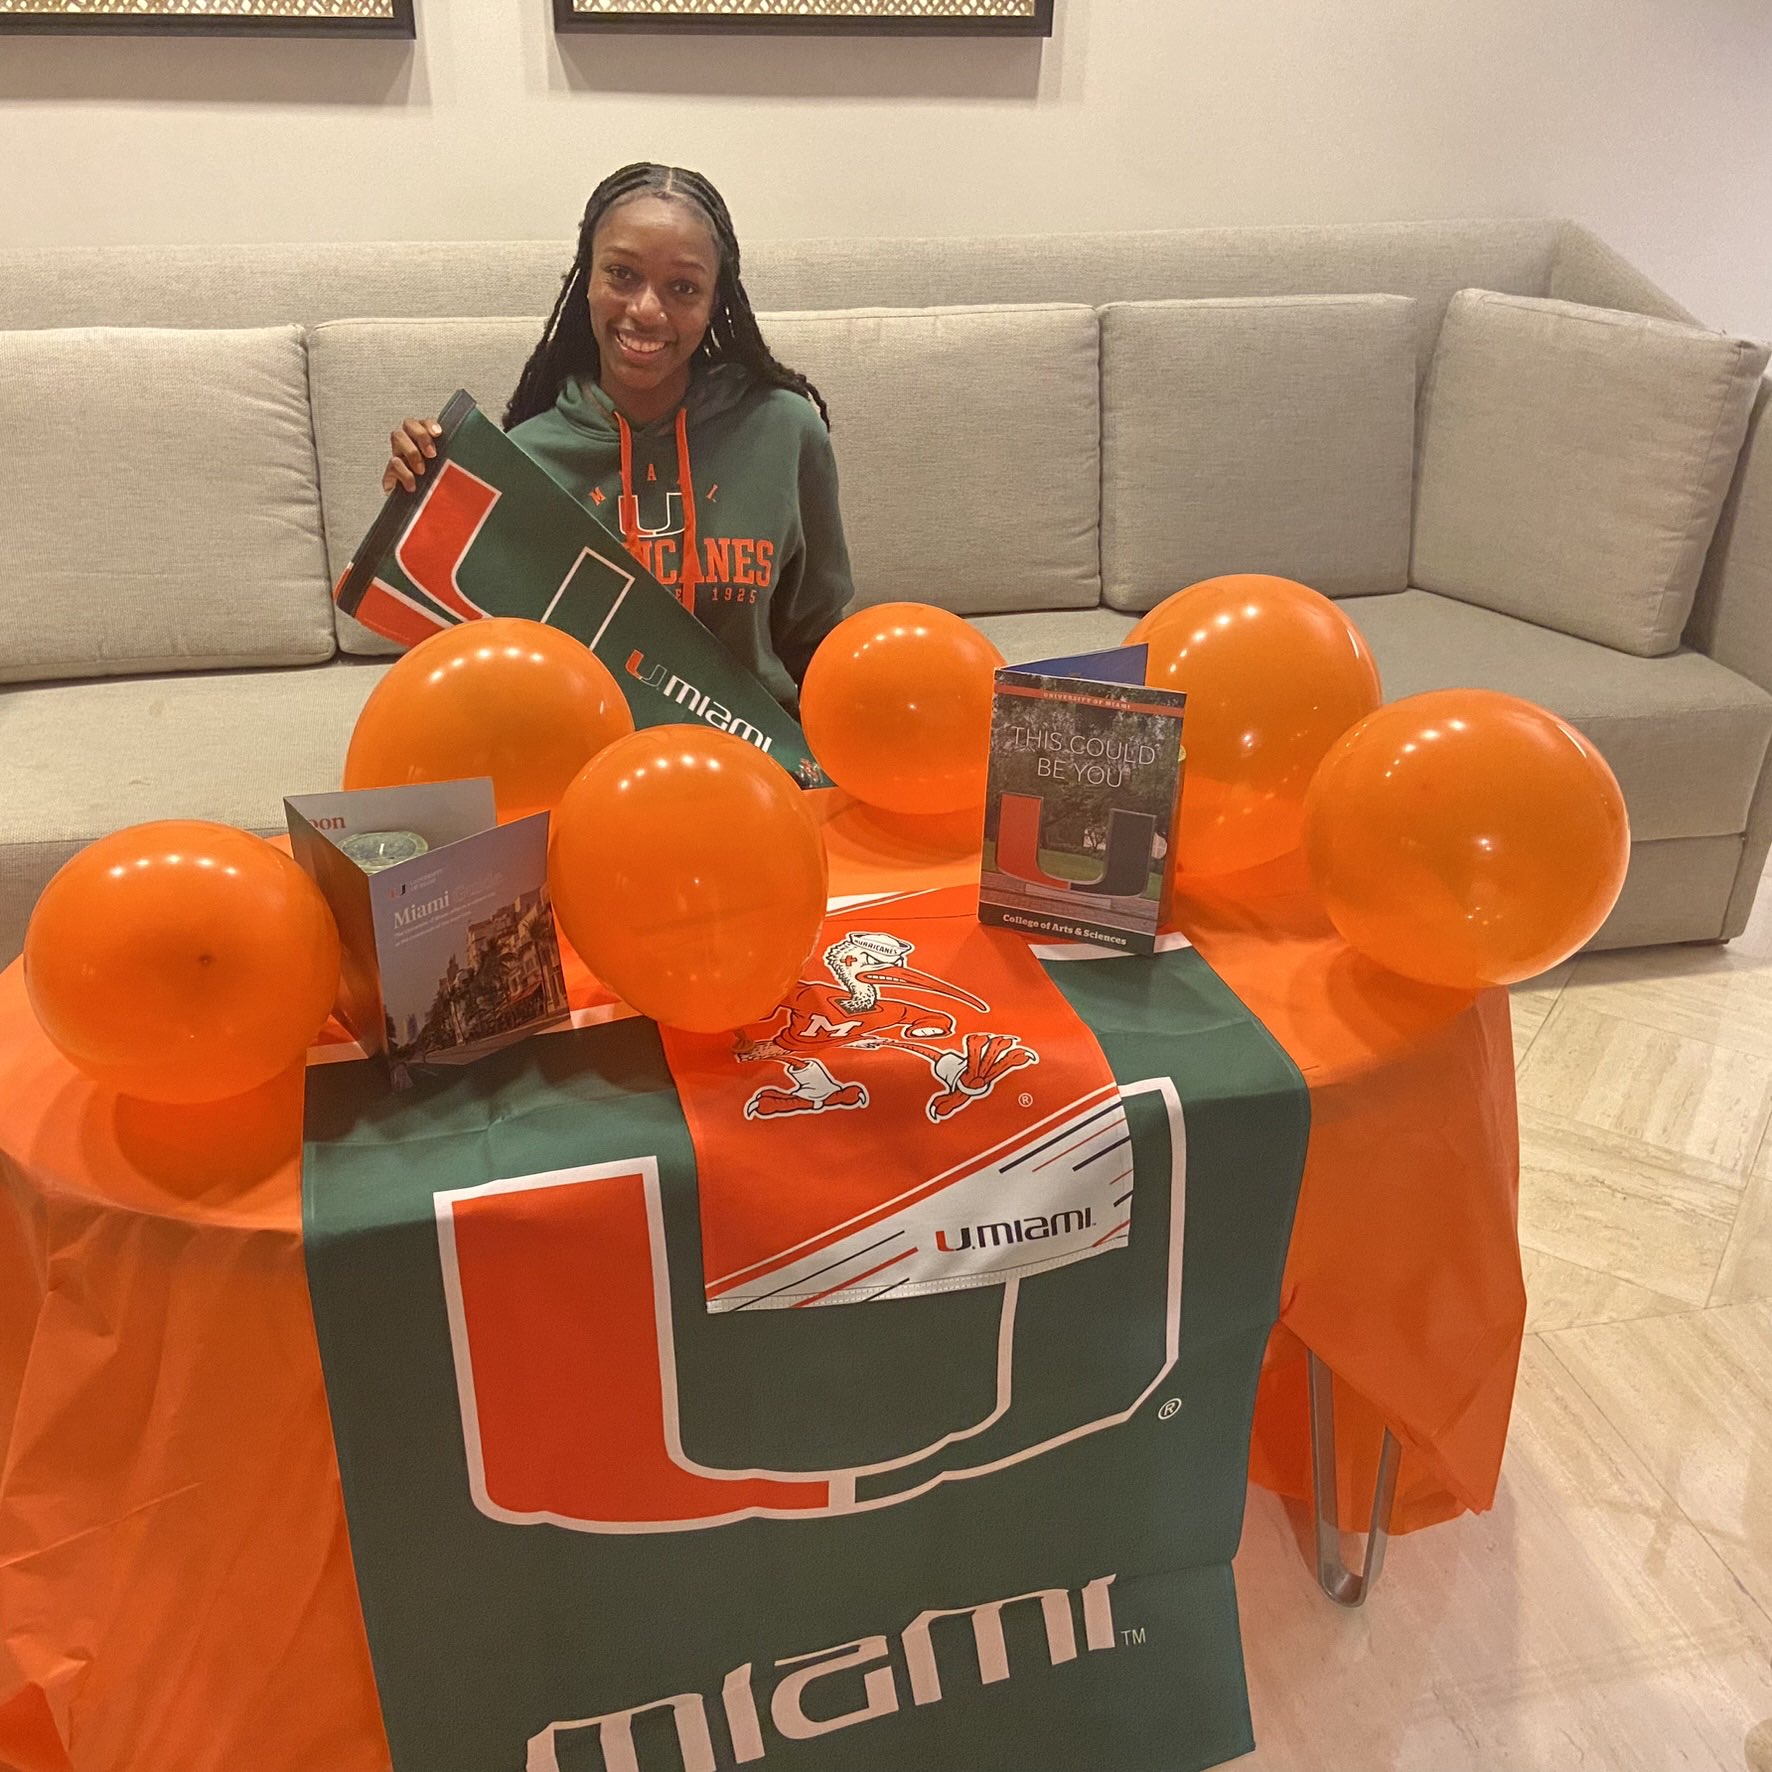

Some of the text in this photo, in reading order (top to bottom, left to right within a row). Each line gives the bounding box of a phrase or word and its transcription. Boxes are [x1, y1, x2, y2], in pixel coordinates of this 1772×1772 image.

[711, 587, 758, 604] 1925
[1043, 691, 1131, 710] UNIVERSITY OF MIAMI
[1011, 726, 1155, 765] THIS COULD
[1037, 757, 1123, 788] BE YOU
[393, 890, 450, 929] Miami
[1002, 913, 1127, 946] College of Arts & Sciences
[854, 939, 898, 955] HURRICANES
[799, 1014, 863, 1038] M
